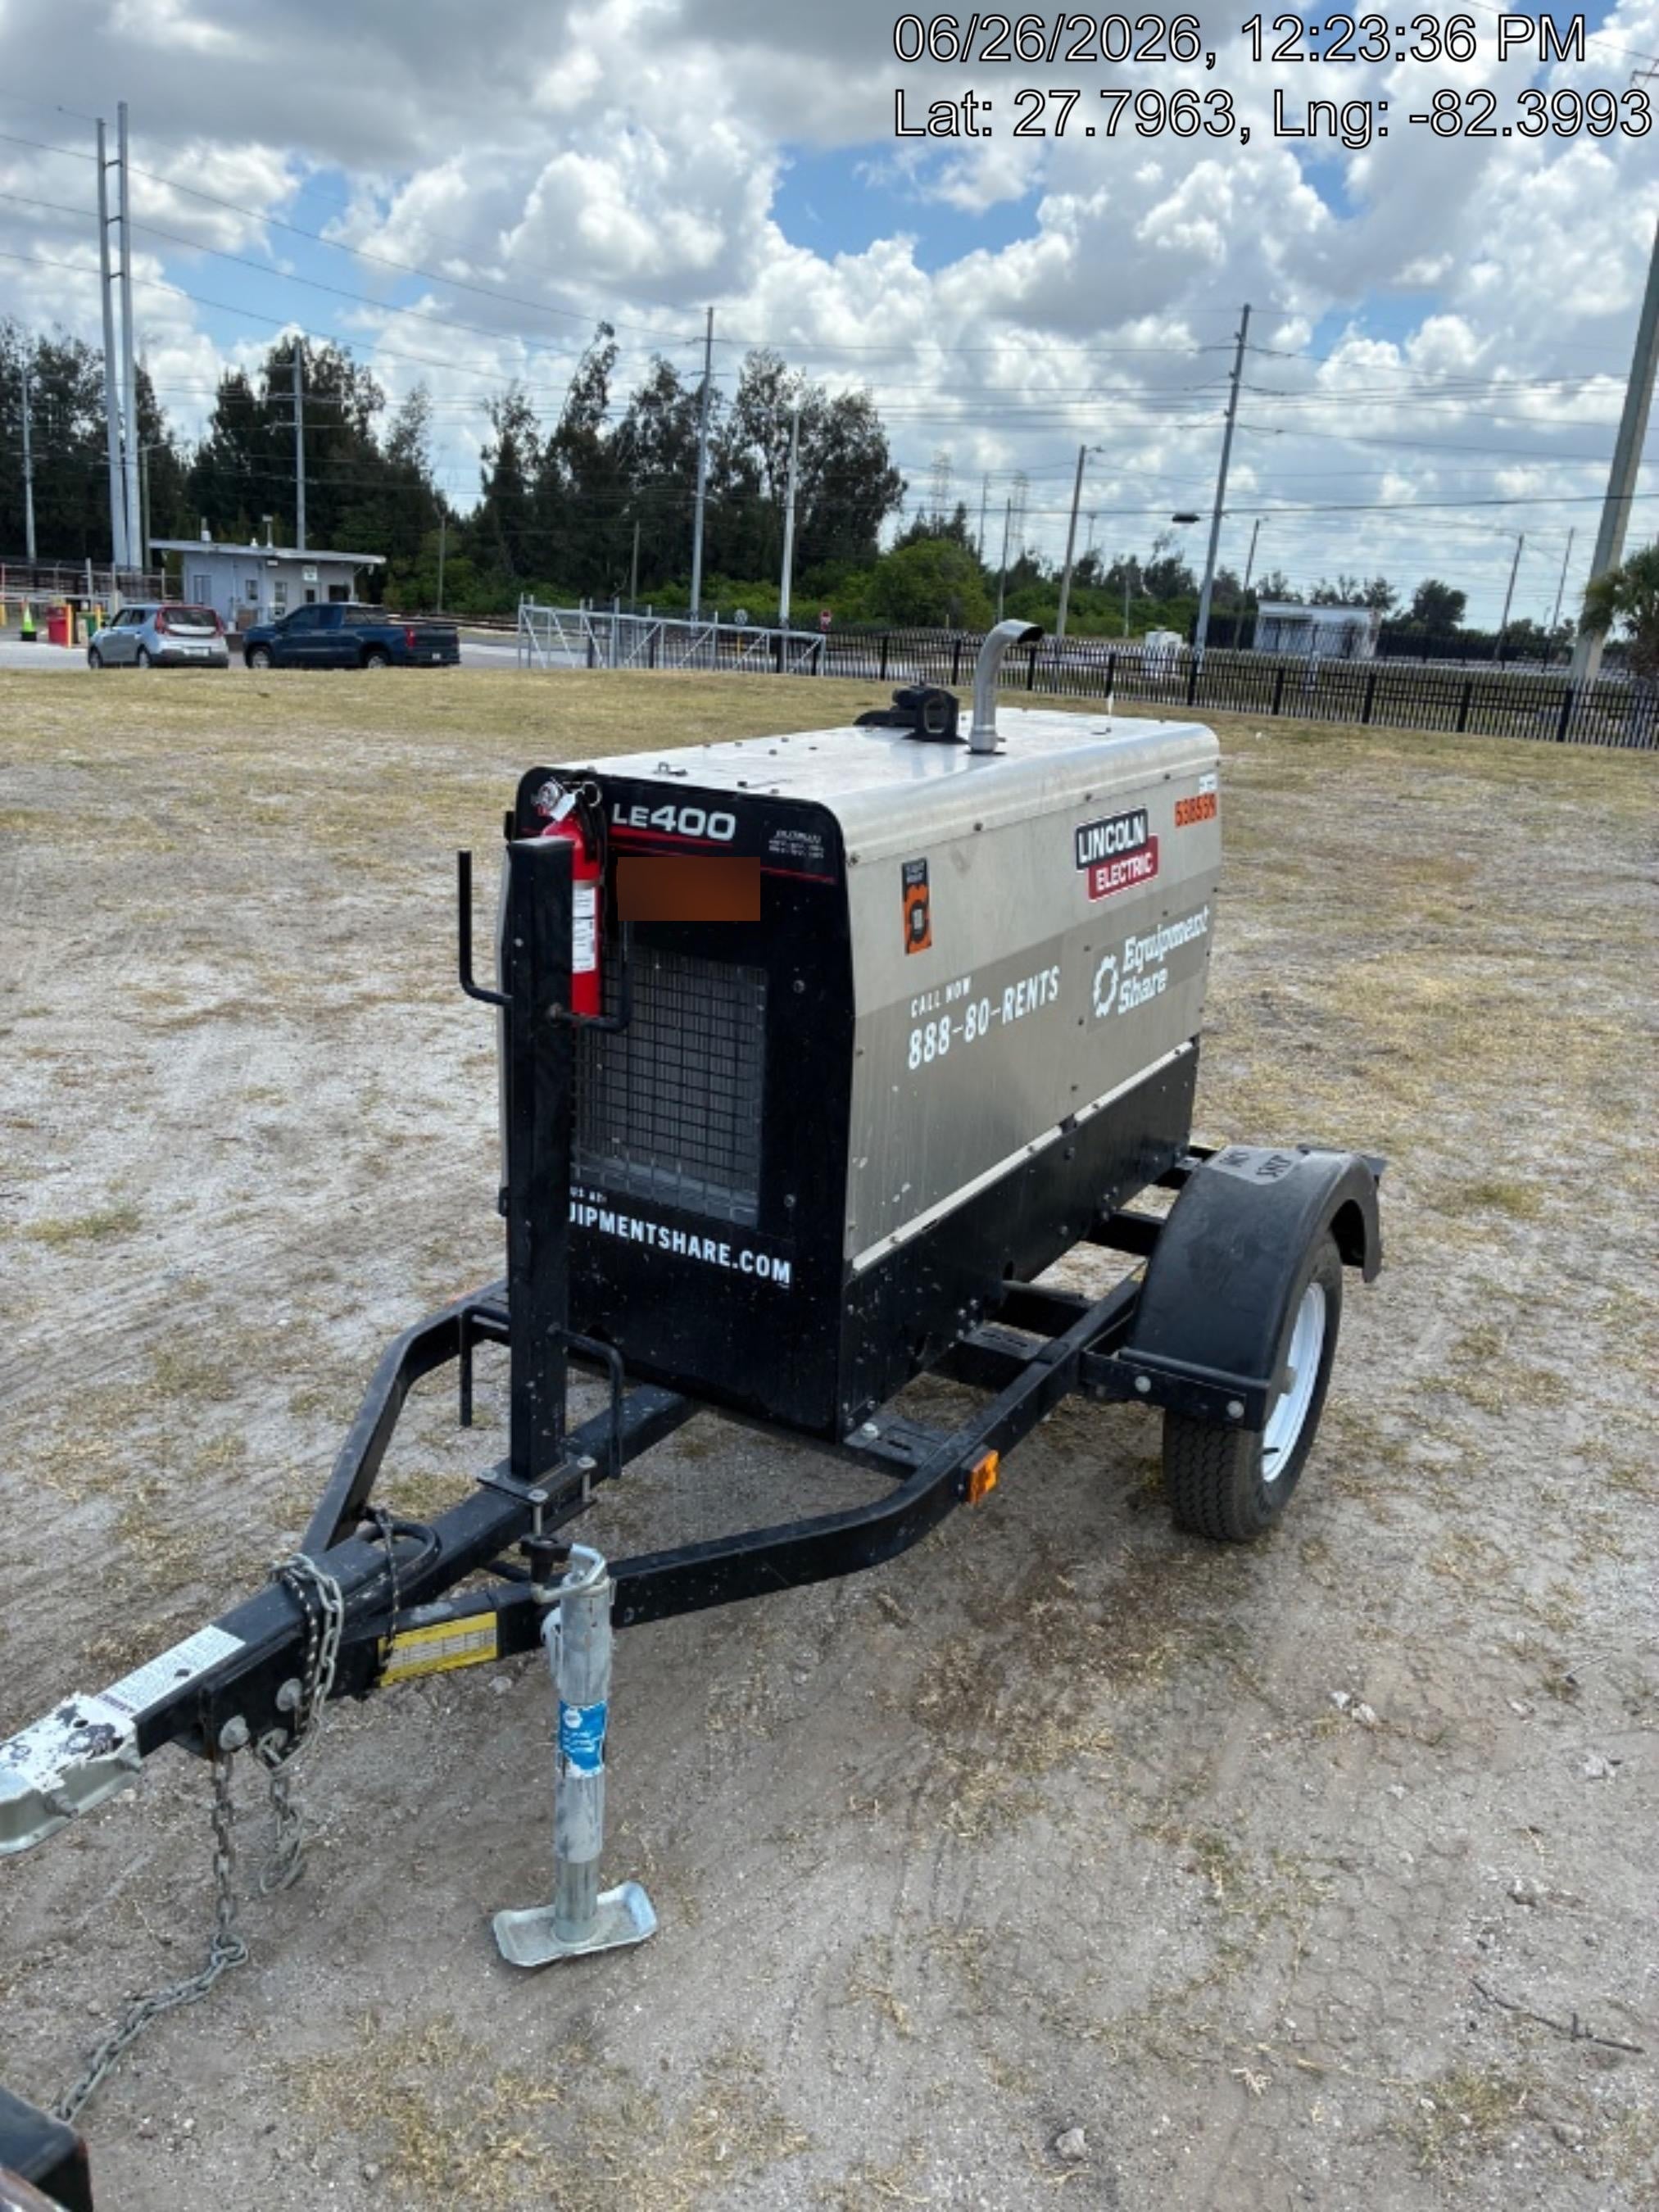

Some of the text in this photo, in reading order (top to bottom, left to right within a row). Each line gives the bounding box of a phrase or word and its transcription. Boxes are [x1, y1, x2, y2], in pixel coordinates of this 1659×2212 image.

[1078, 814, 1145, 864] LINCOLN
[1095, 851, 1154, 891] ELECTRIC
[1122, 904, 1209, 974] Equipment
[911, 975, 972, 1018] CALL NOW
[1117, 968, 1168, 1016] Share
[909, 965, 1060, 1071] 888-80-RENTS
[569, 1201, 791, 1284] UIPMENTSHARE.COM
